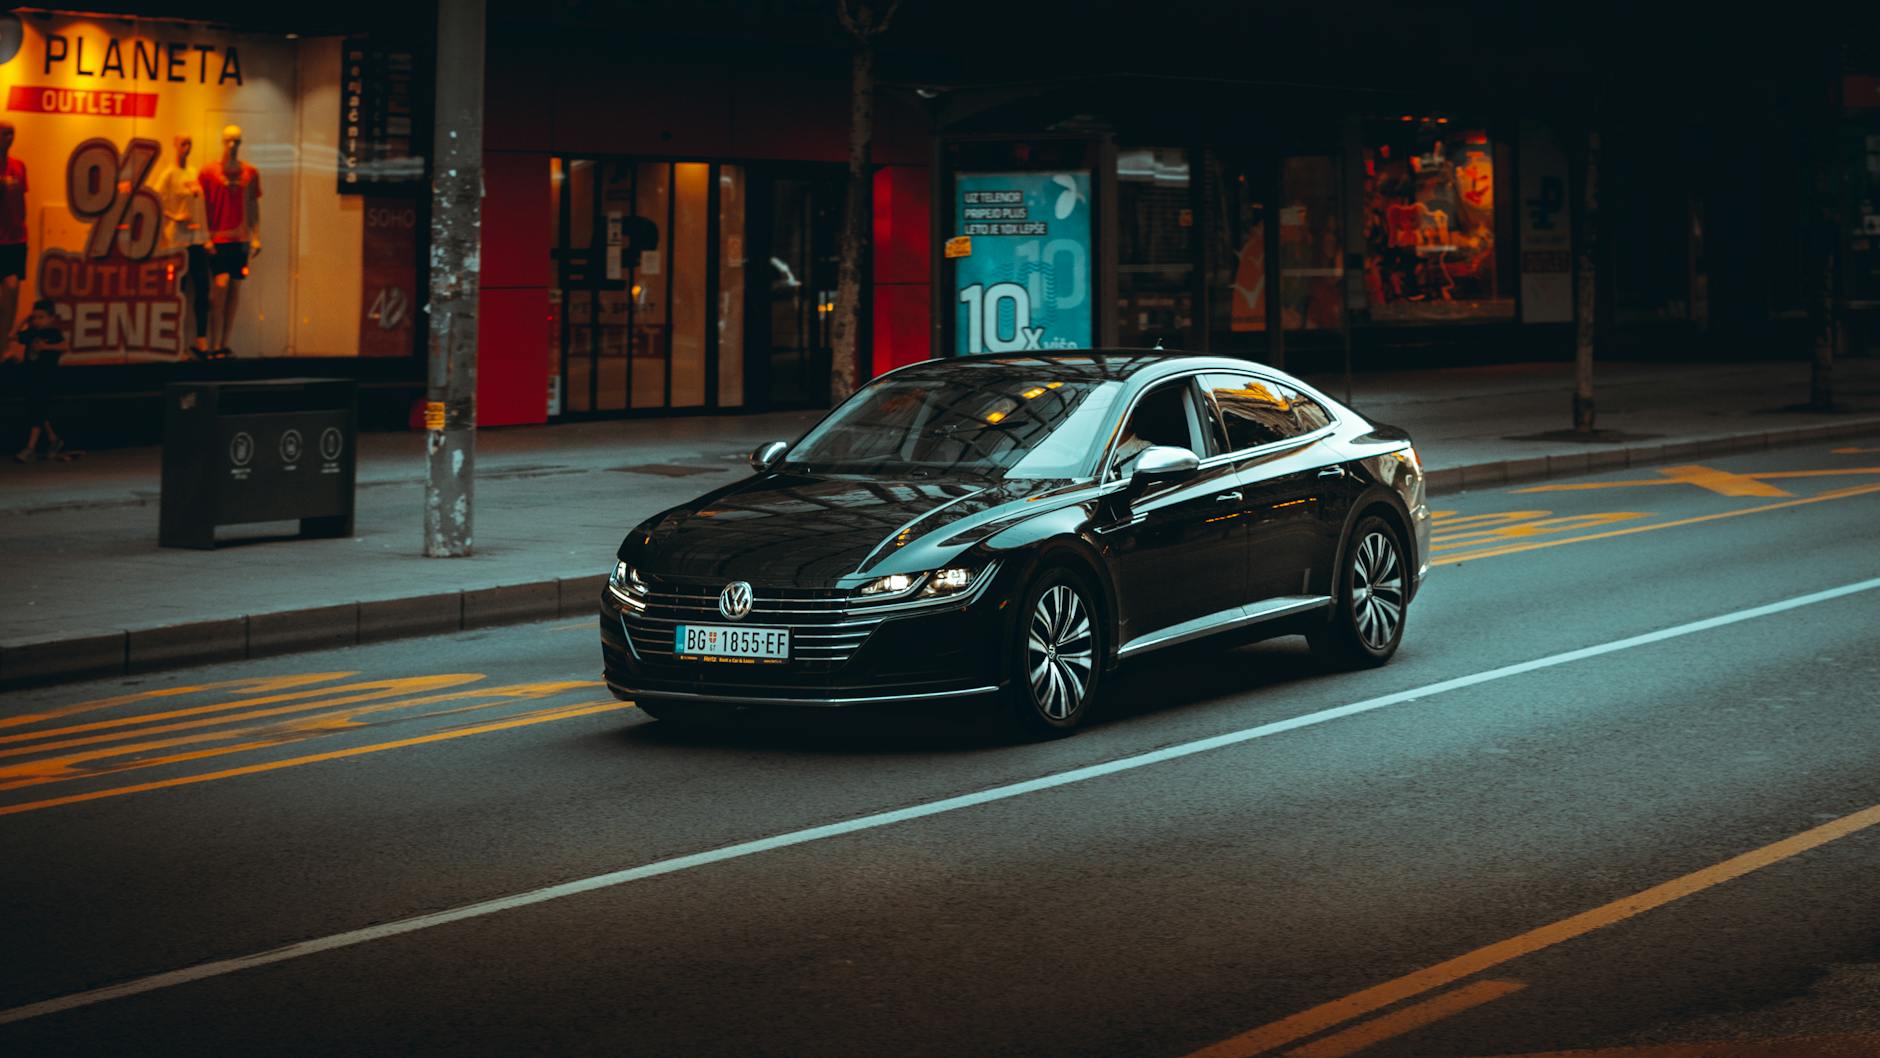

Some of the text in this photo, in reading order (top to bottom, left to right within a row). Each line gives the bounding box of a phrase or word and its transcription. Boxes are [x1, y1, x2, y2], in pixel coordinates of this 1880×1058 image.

[43, 34, 244, 87] PLANETA
[41, 89, 126, 116] OUTLET
[980, 190, 1022, 204] TELENOR
[366, 207, 416, 229] SOHO
[1002, 207, 1027, 219] PLUS
[964, 223, 989, 235] LETO
[43, 257, 184, 298] OUTLET
[687, 629, 706, 650] BG
